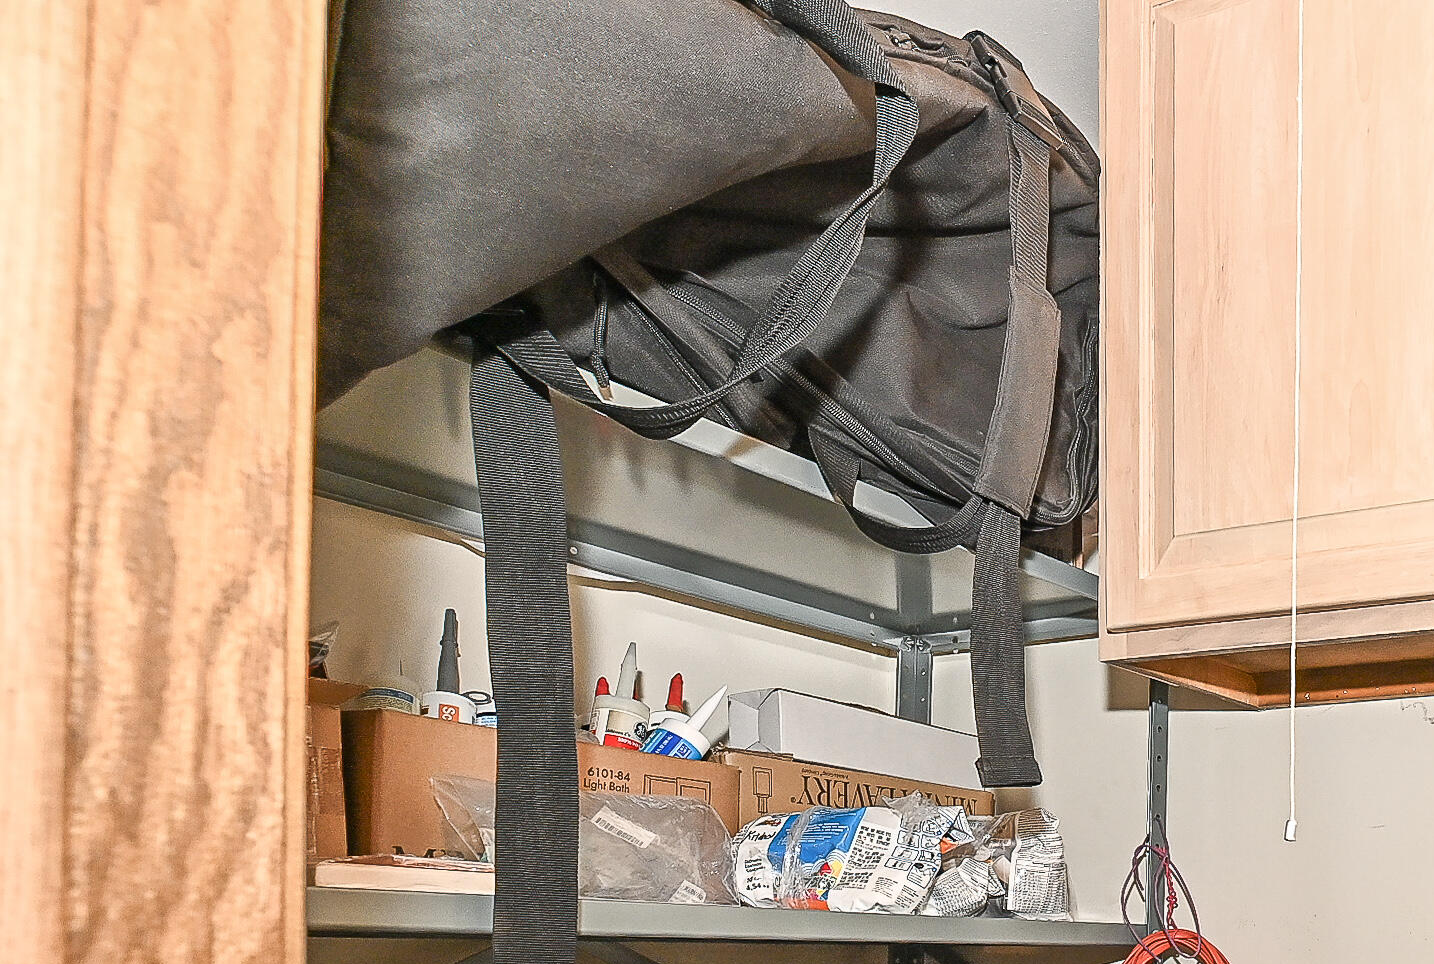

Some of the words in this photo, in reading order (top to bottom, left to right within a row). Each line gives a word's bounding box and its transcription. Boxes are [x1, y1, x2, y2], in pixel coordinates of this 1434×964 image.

[587, 766, 630, 781] 6101-84
[583, 778, 606, 791] Light
[609, 782, 629, 793] Bath
